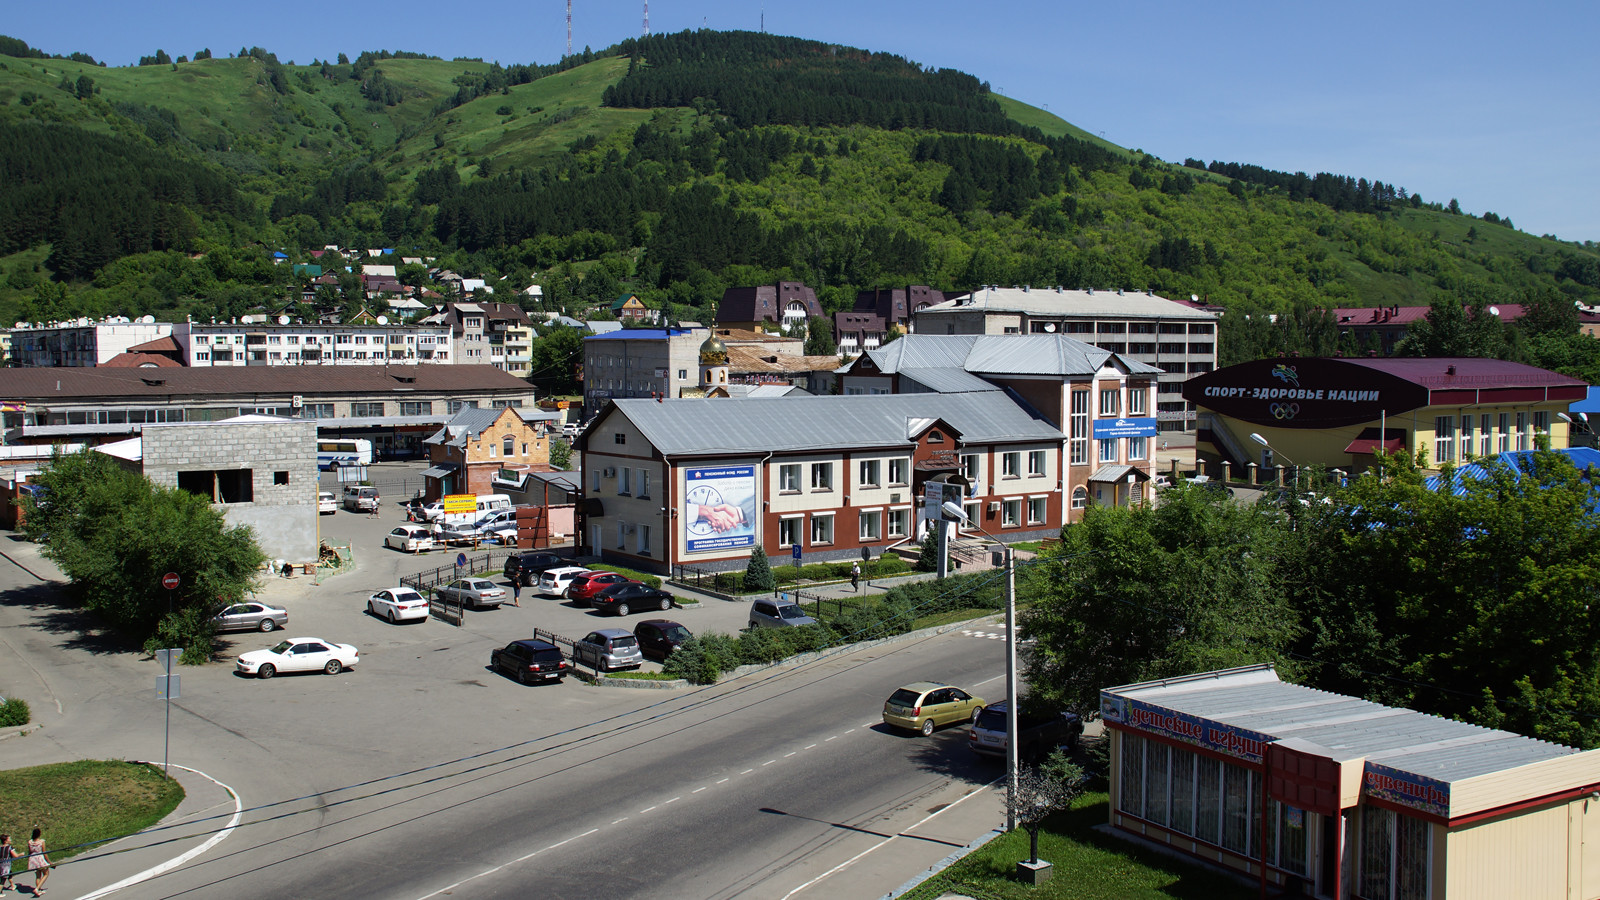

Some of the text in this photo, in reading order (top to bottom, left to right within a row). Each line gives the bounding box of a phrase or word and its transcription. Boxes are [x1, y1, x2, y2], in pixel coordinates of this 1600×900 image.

[1327, 390, 1380, 402] НАЦИИ
[1131, 707, 1203, 739] детские
[1364, 771, 1450, 806] сувениры
